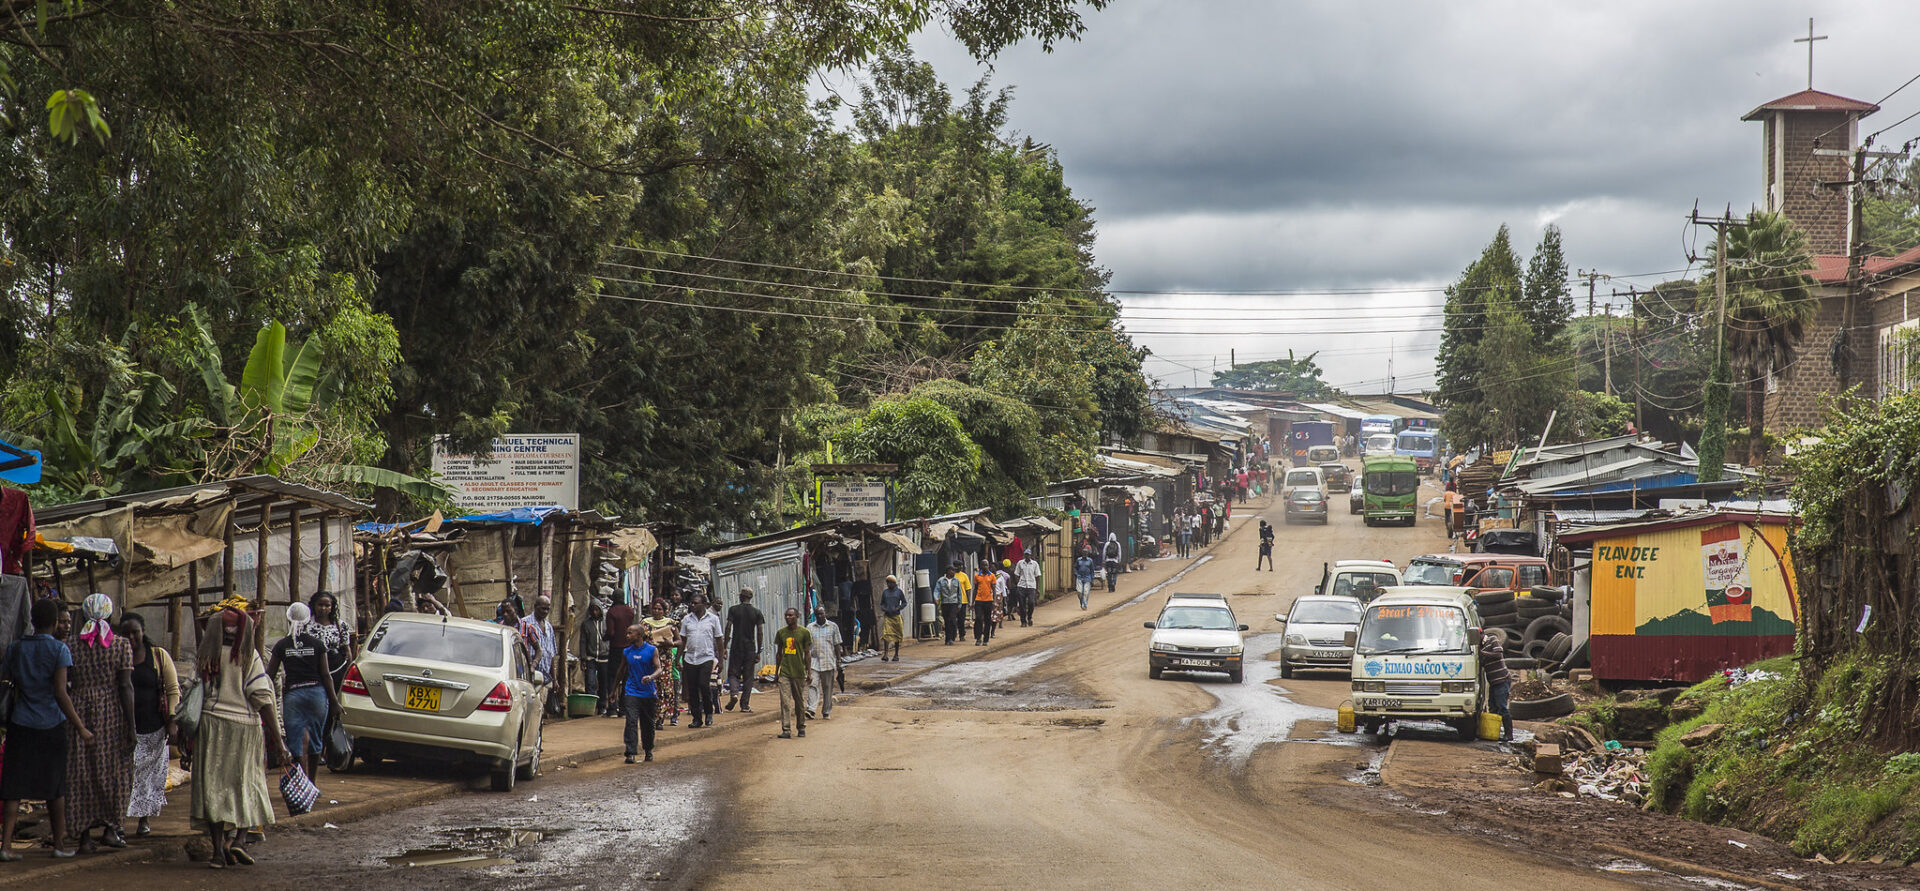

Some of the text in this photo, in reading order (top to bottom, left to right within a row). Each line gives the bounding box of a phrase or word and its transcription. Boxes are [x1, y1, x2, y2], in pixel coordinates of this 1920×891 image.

[513, 445, 547, 453] CENTRE
[1615, 565, 1646, 579] ENT.
[1384, 662, 1412, 674] KIMAO
[1414, 663, 1441, 675] SACCO
[409, 686, 432, 698] KBX
[408, 698, 438, 710] 477U
[1362, 698, 1377, 706] KAR
